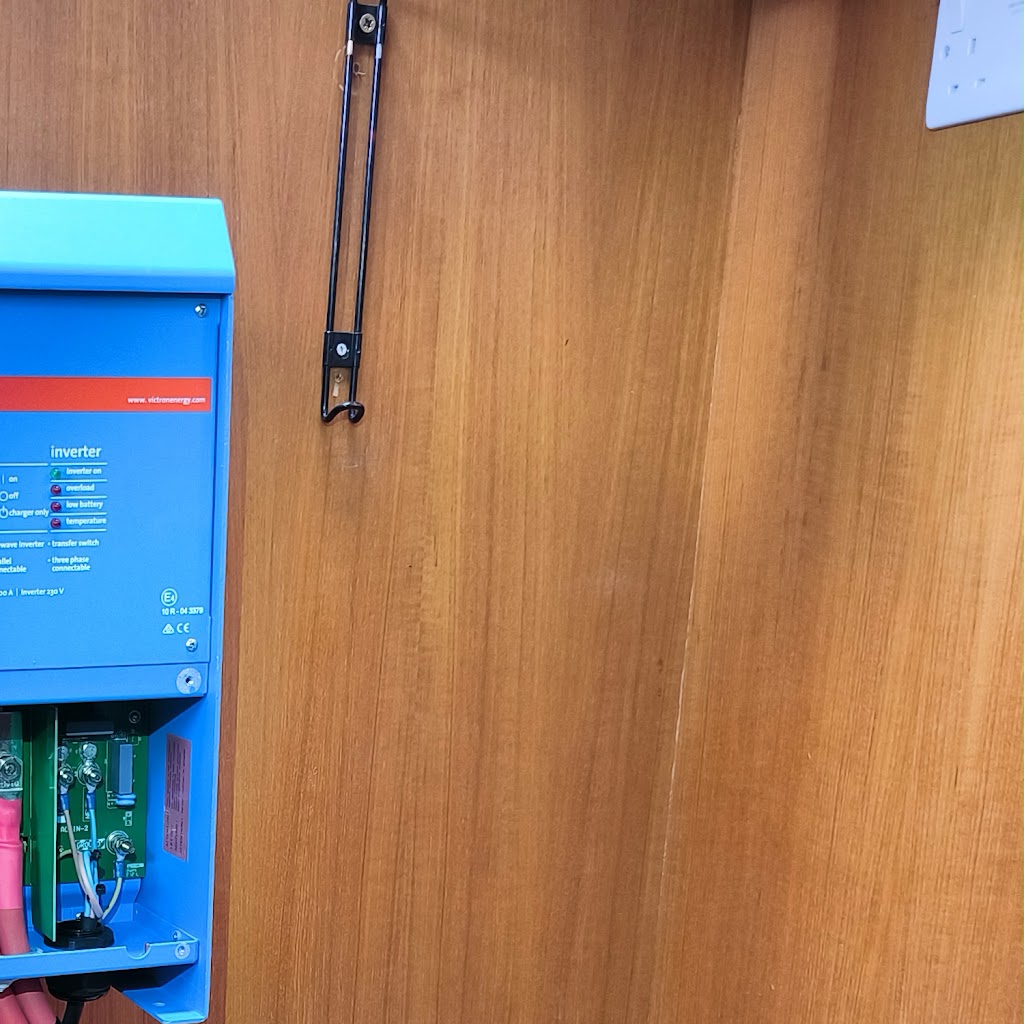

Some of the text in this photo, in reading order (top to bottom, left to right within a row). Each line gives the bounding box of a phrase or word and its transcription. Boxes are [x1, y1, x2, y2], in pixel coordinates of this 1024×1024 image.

[50, 445, 102, 458] inverter
[66, 467, 90, 475] inverter
[66, 483, 95, 492] overload
[8, 492, 19, 500] off
[79, 501, 103, 510] battery
[8, 508, 49, 518] charger only
[66, 517, 107, 526] temperature
[18, 540, 45, 549] inverter
[51, 539, 100, 547] transfer switch
[51, 556, 90, 565] three phase
[51, 564, 91, 572] connectable
